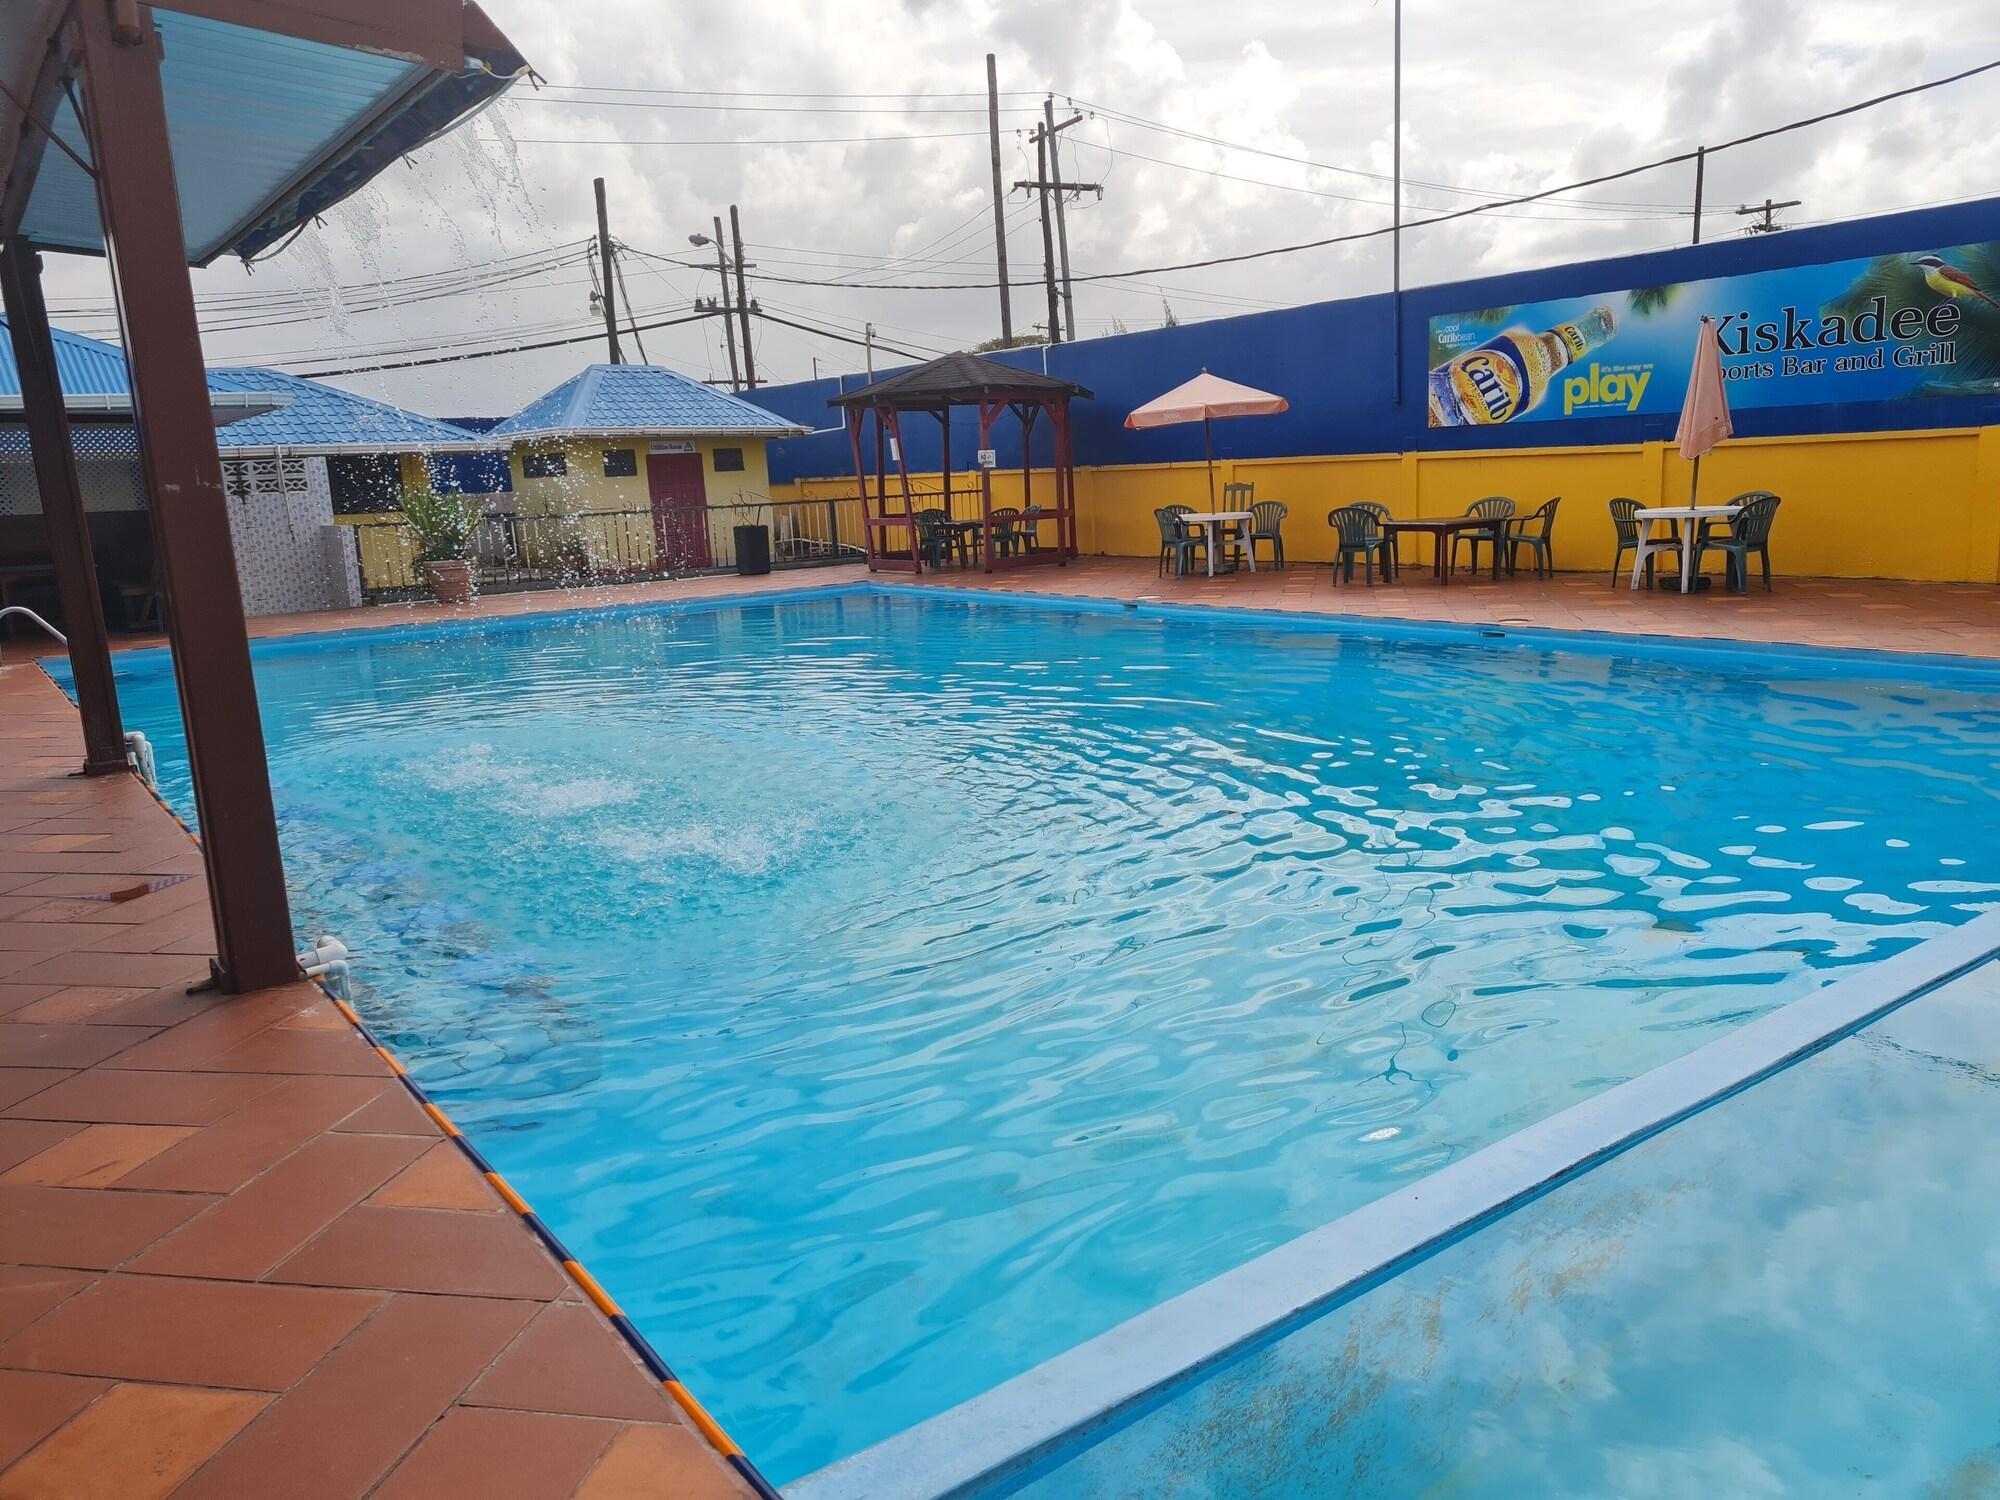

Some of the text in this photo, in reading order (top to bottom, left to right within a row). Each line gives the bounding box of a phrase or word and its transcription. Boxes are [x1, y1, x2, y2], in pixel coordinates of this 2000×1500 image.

[1438, 332, 1475, 343] Caribbean
[1564, 326, 1584, 351] Carib
[1713, 295, 1961, 356] Kiskadee
[1781, 355, 1827, 377] Bar
[1834, 348, 1884, 371] and
[1893, 341, 1957, 368] Grill
[1460, 356, 1512, 420] Carib
[1564, 362, 1651, 416] play
